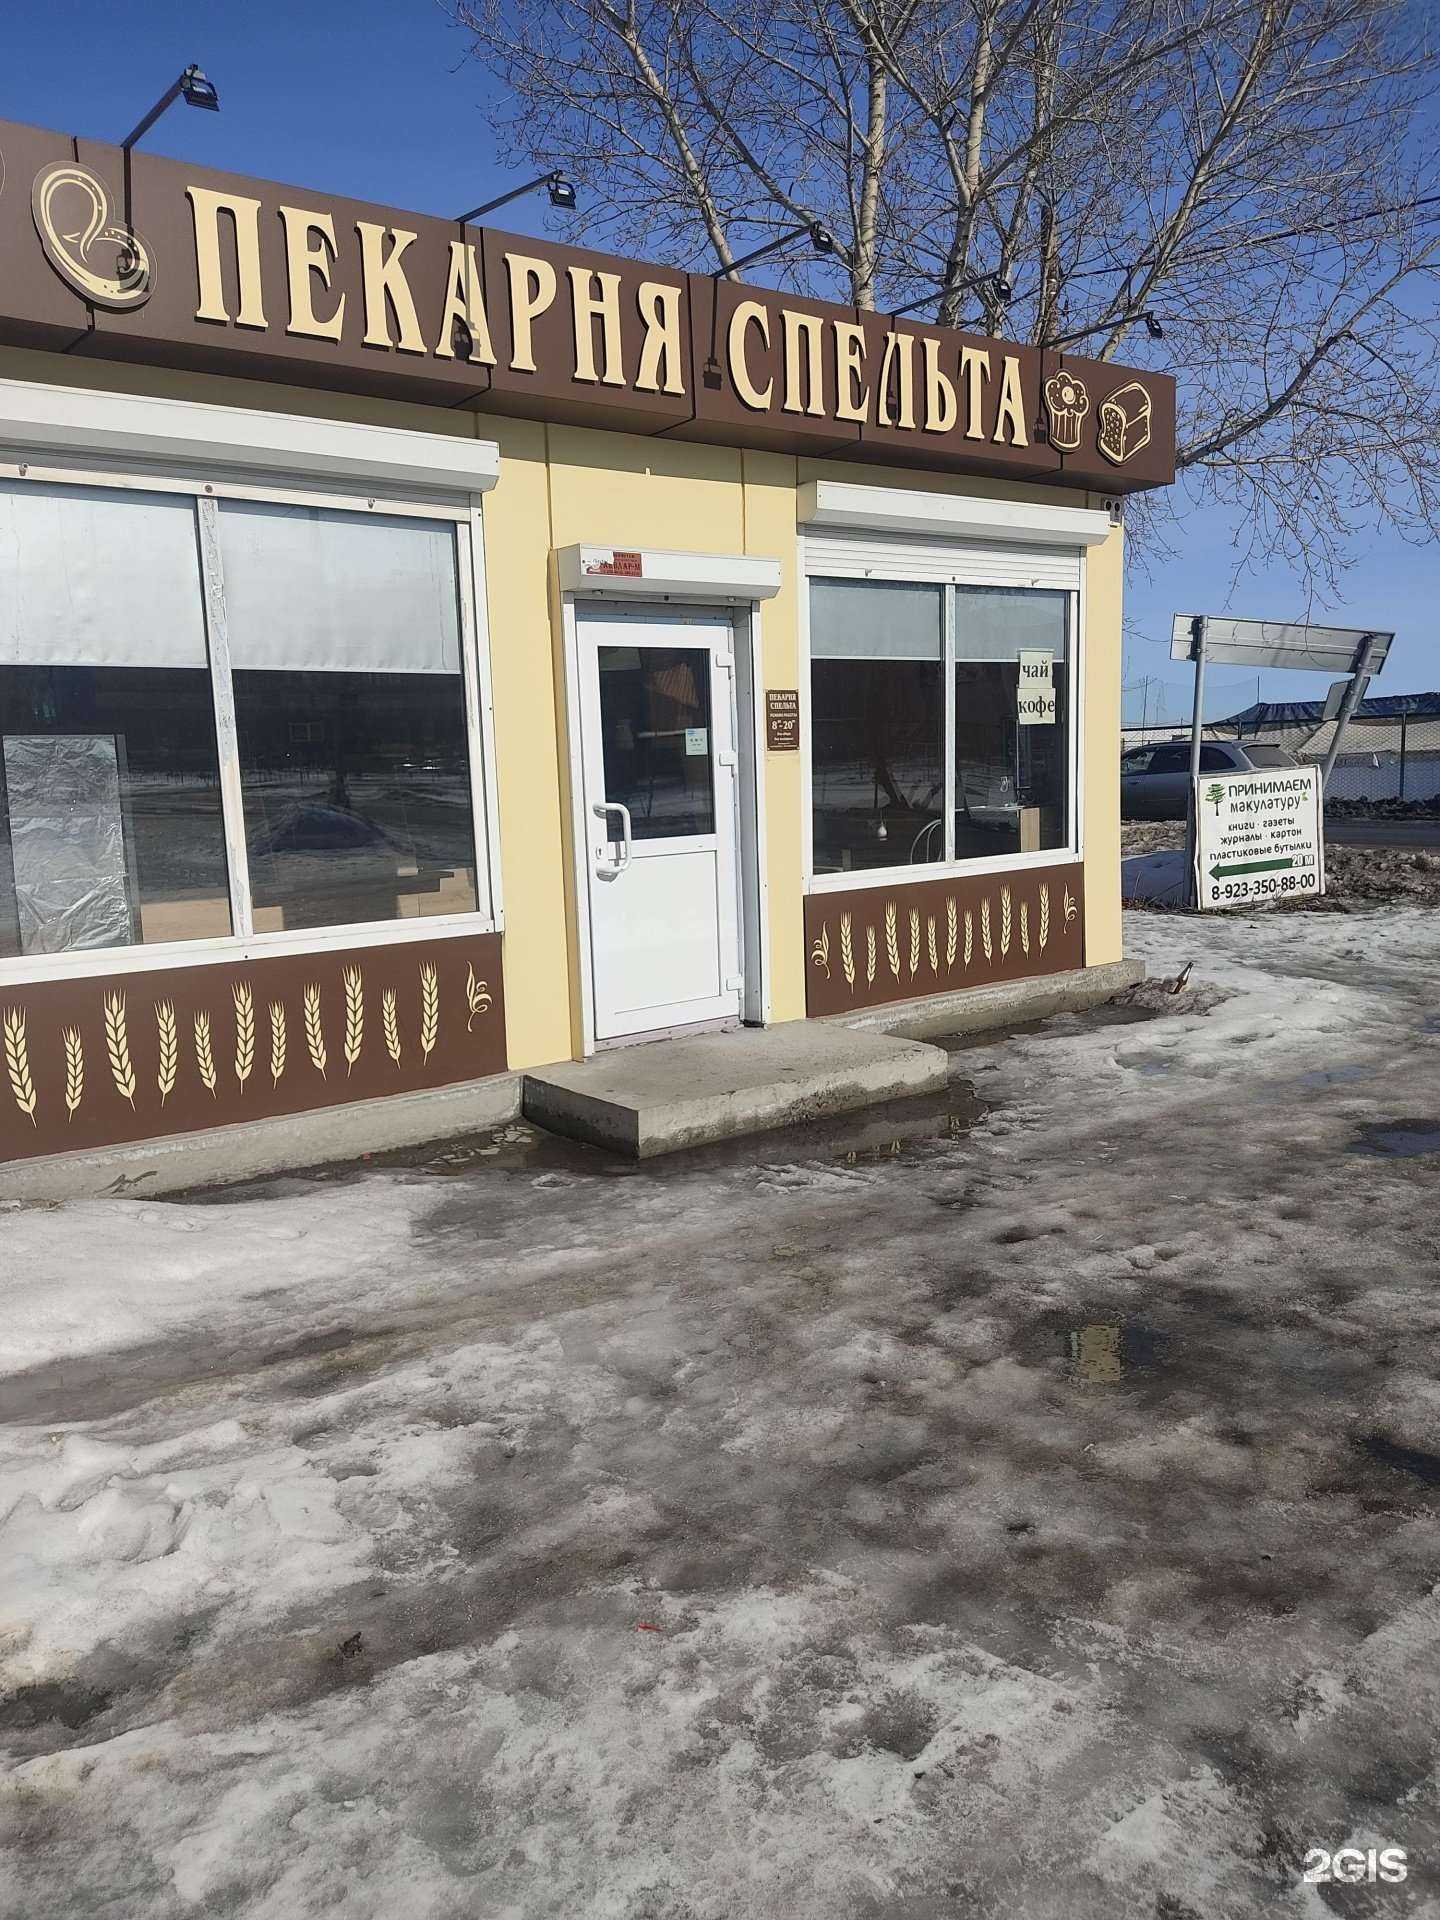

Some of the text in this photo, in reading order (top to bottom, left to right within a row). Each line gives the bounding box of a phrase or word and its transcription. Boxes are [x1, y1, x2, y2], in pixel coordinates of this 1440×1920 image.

[187, 185, 1029, 447] ПЕКАРНЯ СПЕЛЬТА
[1022, 660, 1049, 678] чай
[1018, 696, 1055, 718] кофе
[1228, 778, 1312, 798] ПРИНИМАЕМ
[1230, 795, 1301, 814] макулатуру
[1228, 817, 1295, 832] книги газеты
[1220, 828, 1302, 846] журналы картон
[1209, 841, 1312, 861] пластиковые бутылки
[1211, 873, 1316, 900] 8-923-350-88-00
